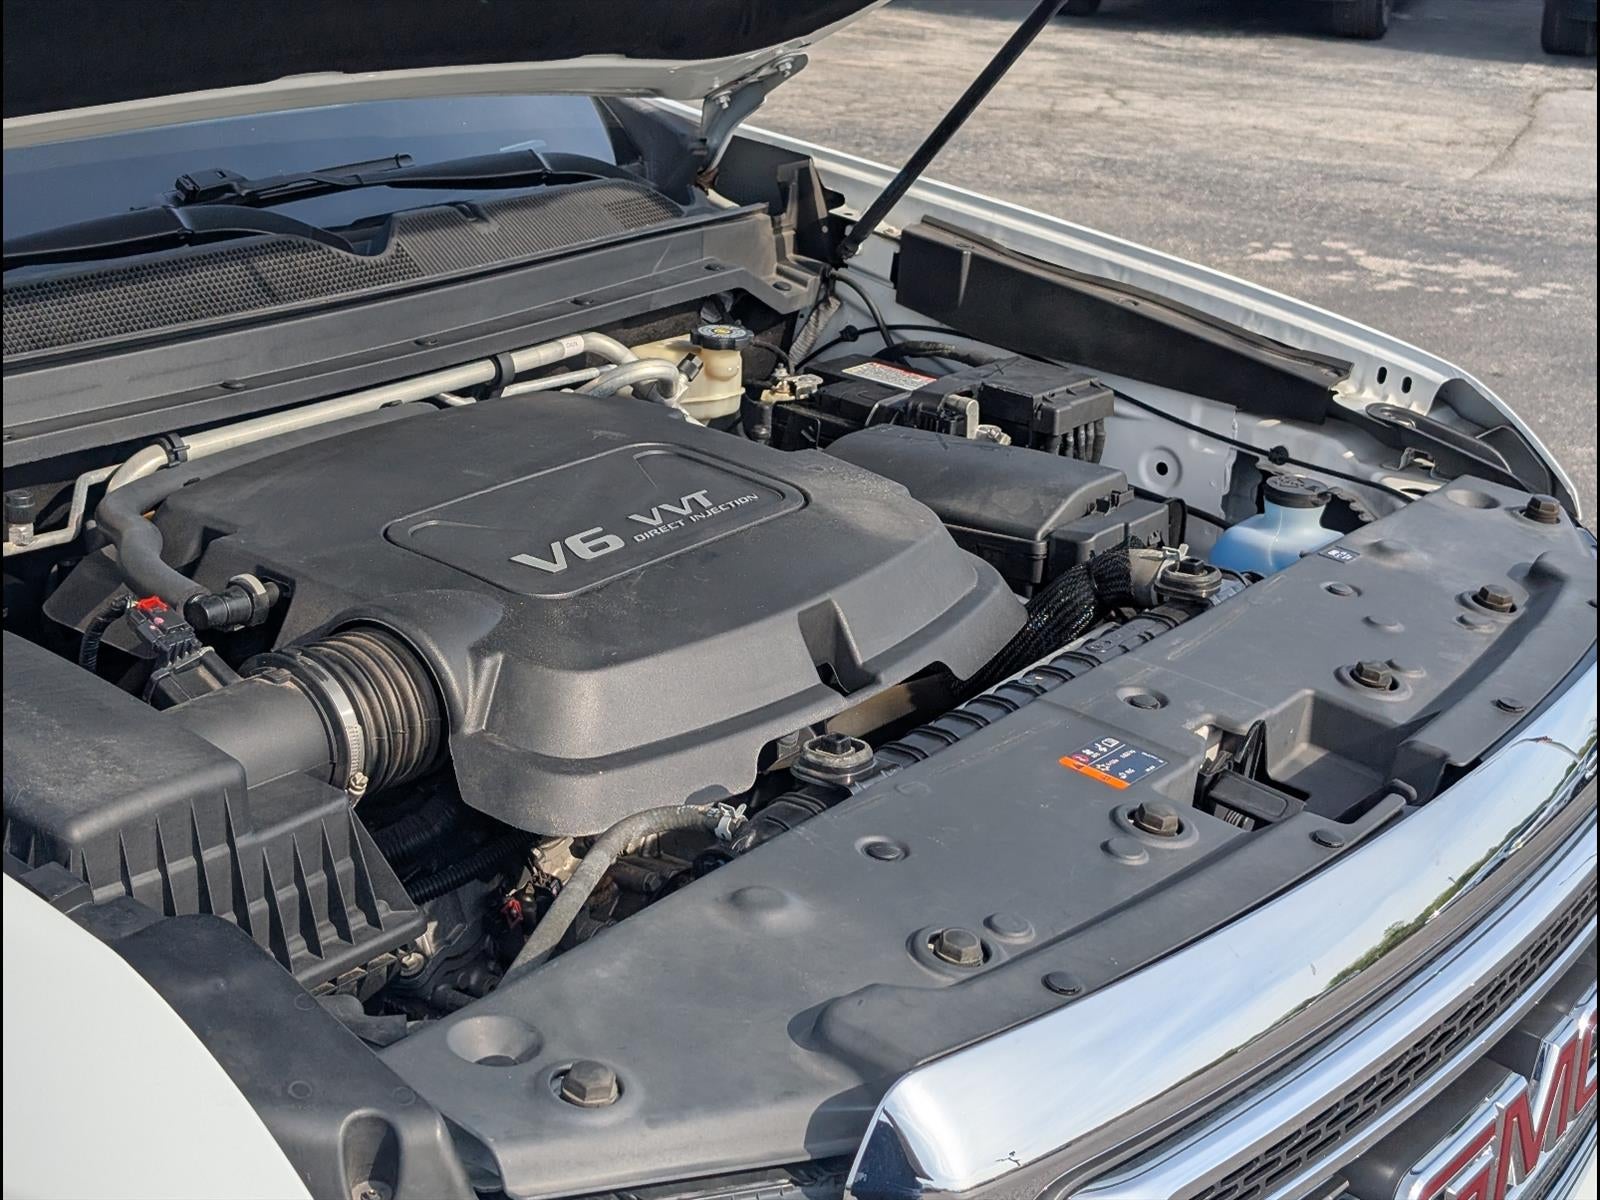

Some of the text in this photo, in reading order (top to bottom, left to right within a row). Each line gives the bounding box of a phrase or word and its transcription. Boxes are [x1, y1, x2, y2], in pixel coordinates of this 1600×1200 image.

[628, 489, 713, 526] VVT
[633, 493, 759, 542] DIRECT INJECTION
[510, 526, 625, 573] V6
